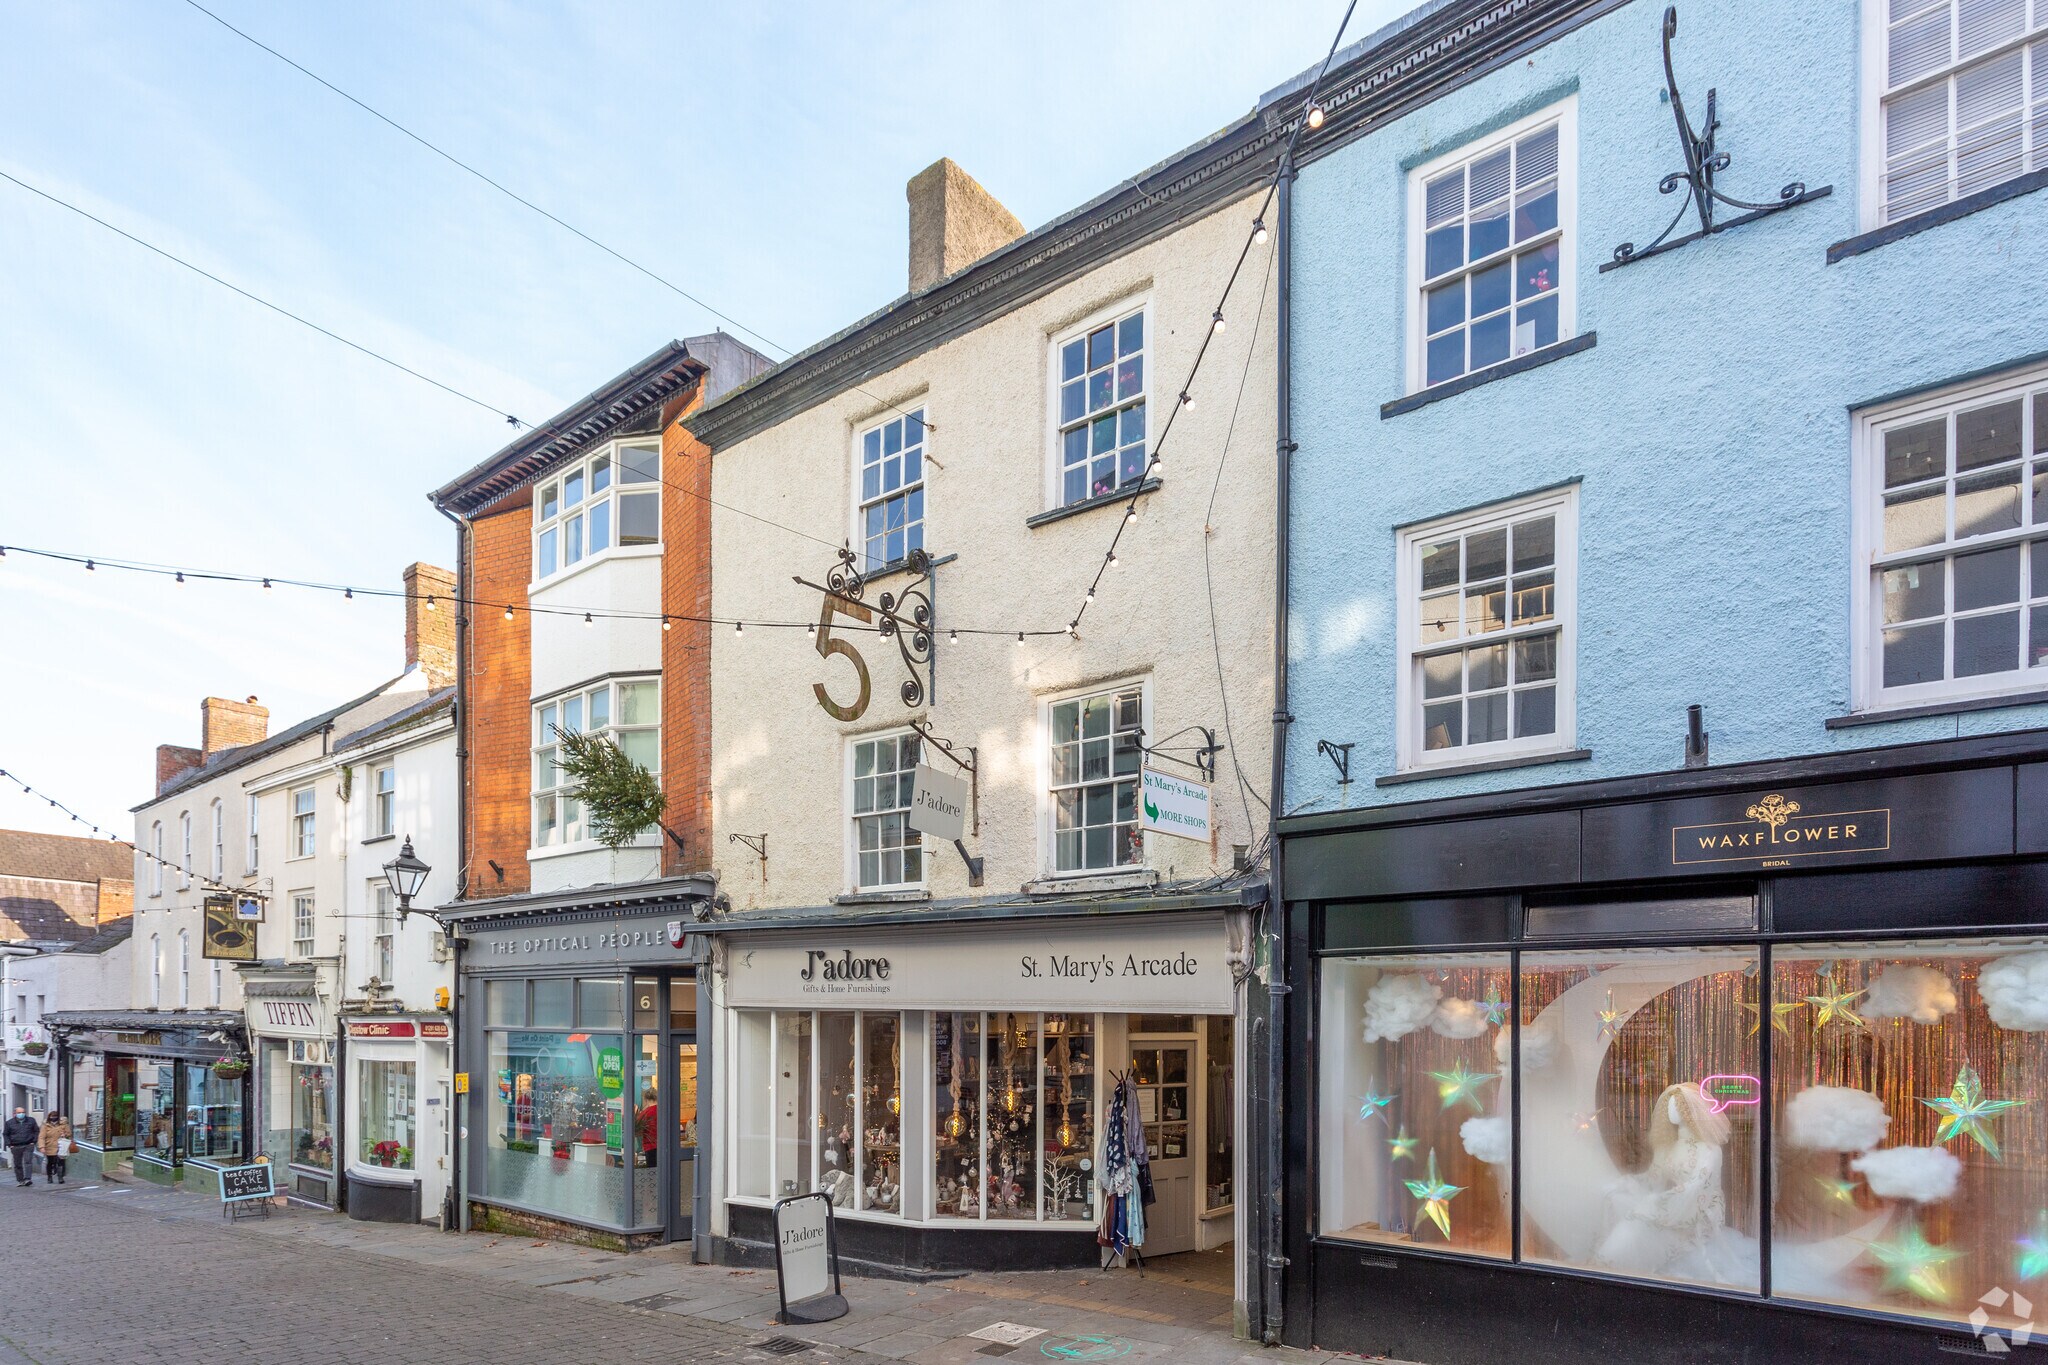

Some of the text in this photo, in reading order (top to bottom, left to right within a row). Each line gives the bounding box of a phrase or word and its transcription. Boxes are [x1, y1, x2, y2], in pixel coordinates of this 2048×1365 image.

[812, 592, 872, 722] 5
[1144, 773, 1207, 801] St Mary's Arcade
[917, 789, 960, 818] J'adore
[1160, 809, 1207, 829] MORE SHOPS
[1699, 824, 1857, 849] WAXFLOWER
[1762, 859, 1790, 868] BRIDAL
[490, 930, 663, 954] THE OPTICAL PEOPLE
[801, 949, 890, 980] J'adore
[1021, 951, 1198, 983] St. Mary's Arcade
[803, 983, 891, 994] Gifts & Home Furnishings
[640, 996, 650, 1009] 6
[263, 1002, 315, 1027] TIFFIN
[369, 1024, 390, 1035] Clinic
[603, 1061, 620, 1071] OPEN
[233, 1174, 263, 1187] CAKE
[782, 1226, 824, 1246] J'adore
